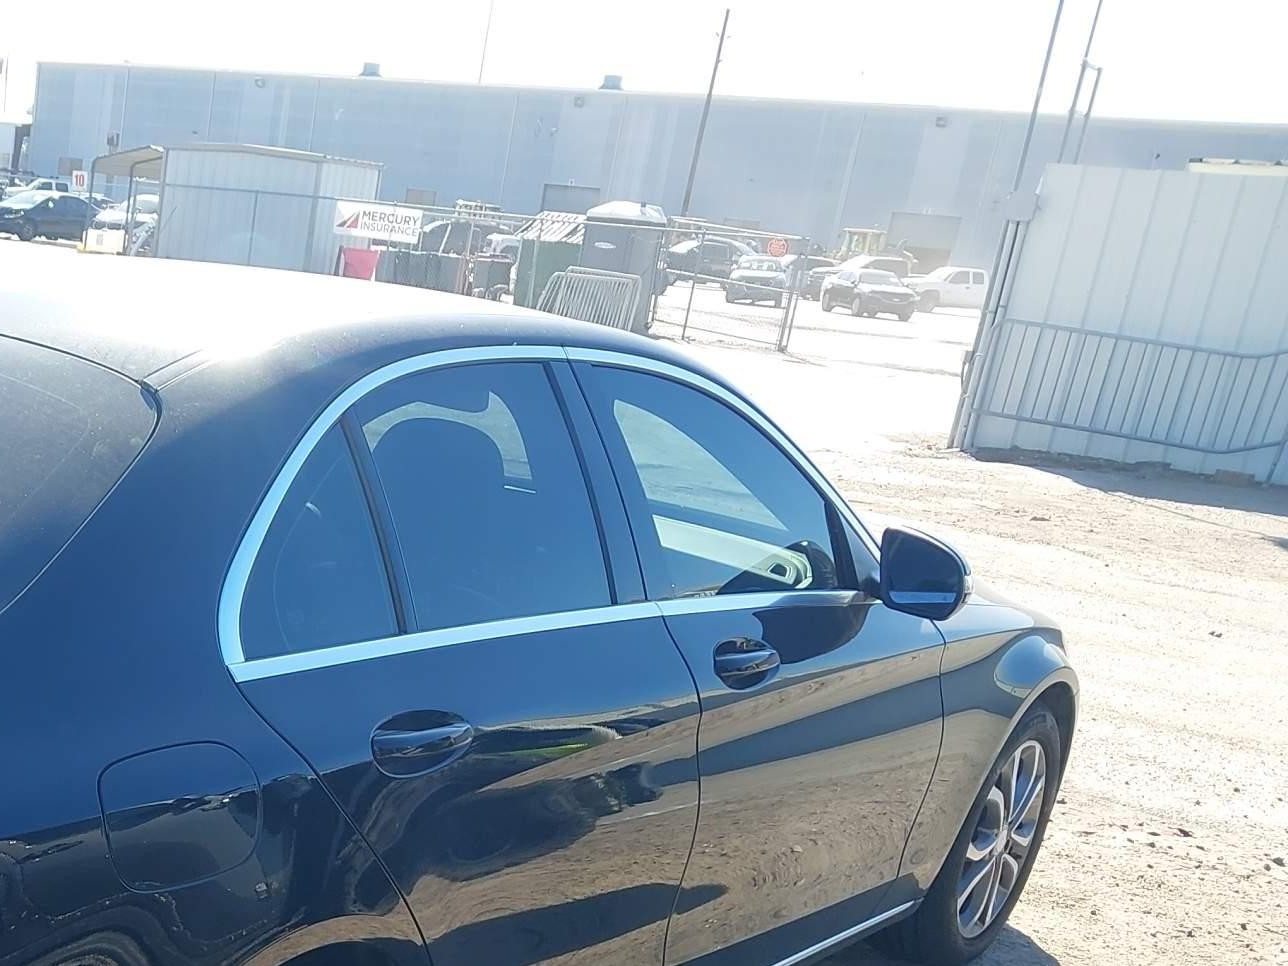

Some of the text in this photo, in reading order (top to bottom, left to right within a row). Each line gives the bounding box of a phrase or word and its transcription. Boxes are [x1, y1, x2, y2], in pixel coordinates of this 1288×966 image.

[75, 174, 85, 187] 10
[361, 210, 420, 226] MERCURY
[360, 222, 419, 237] INSURANCE
